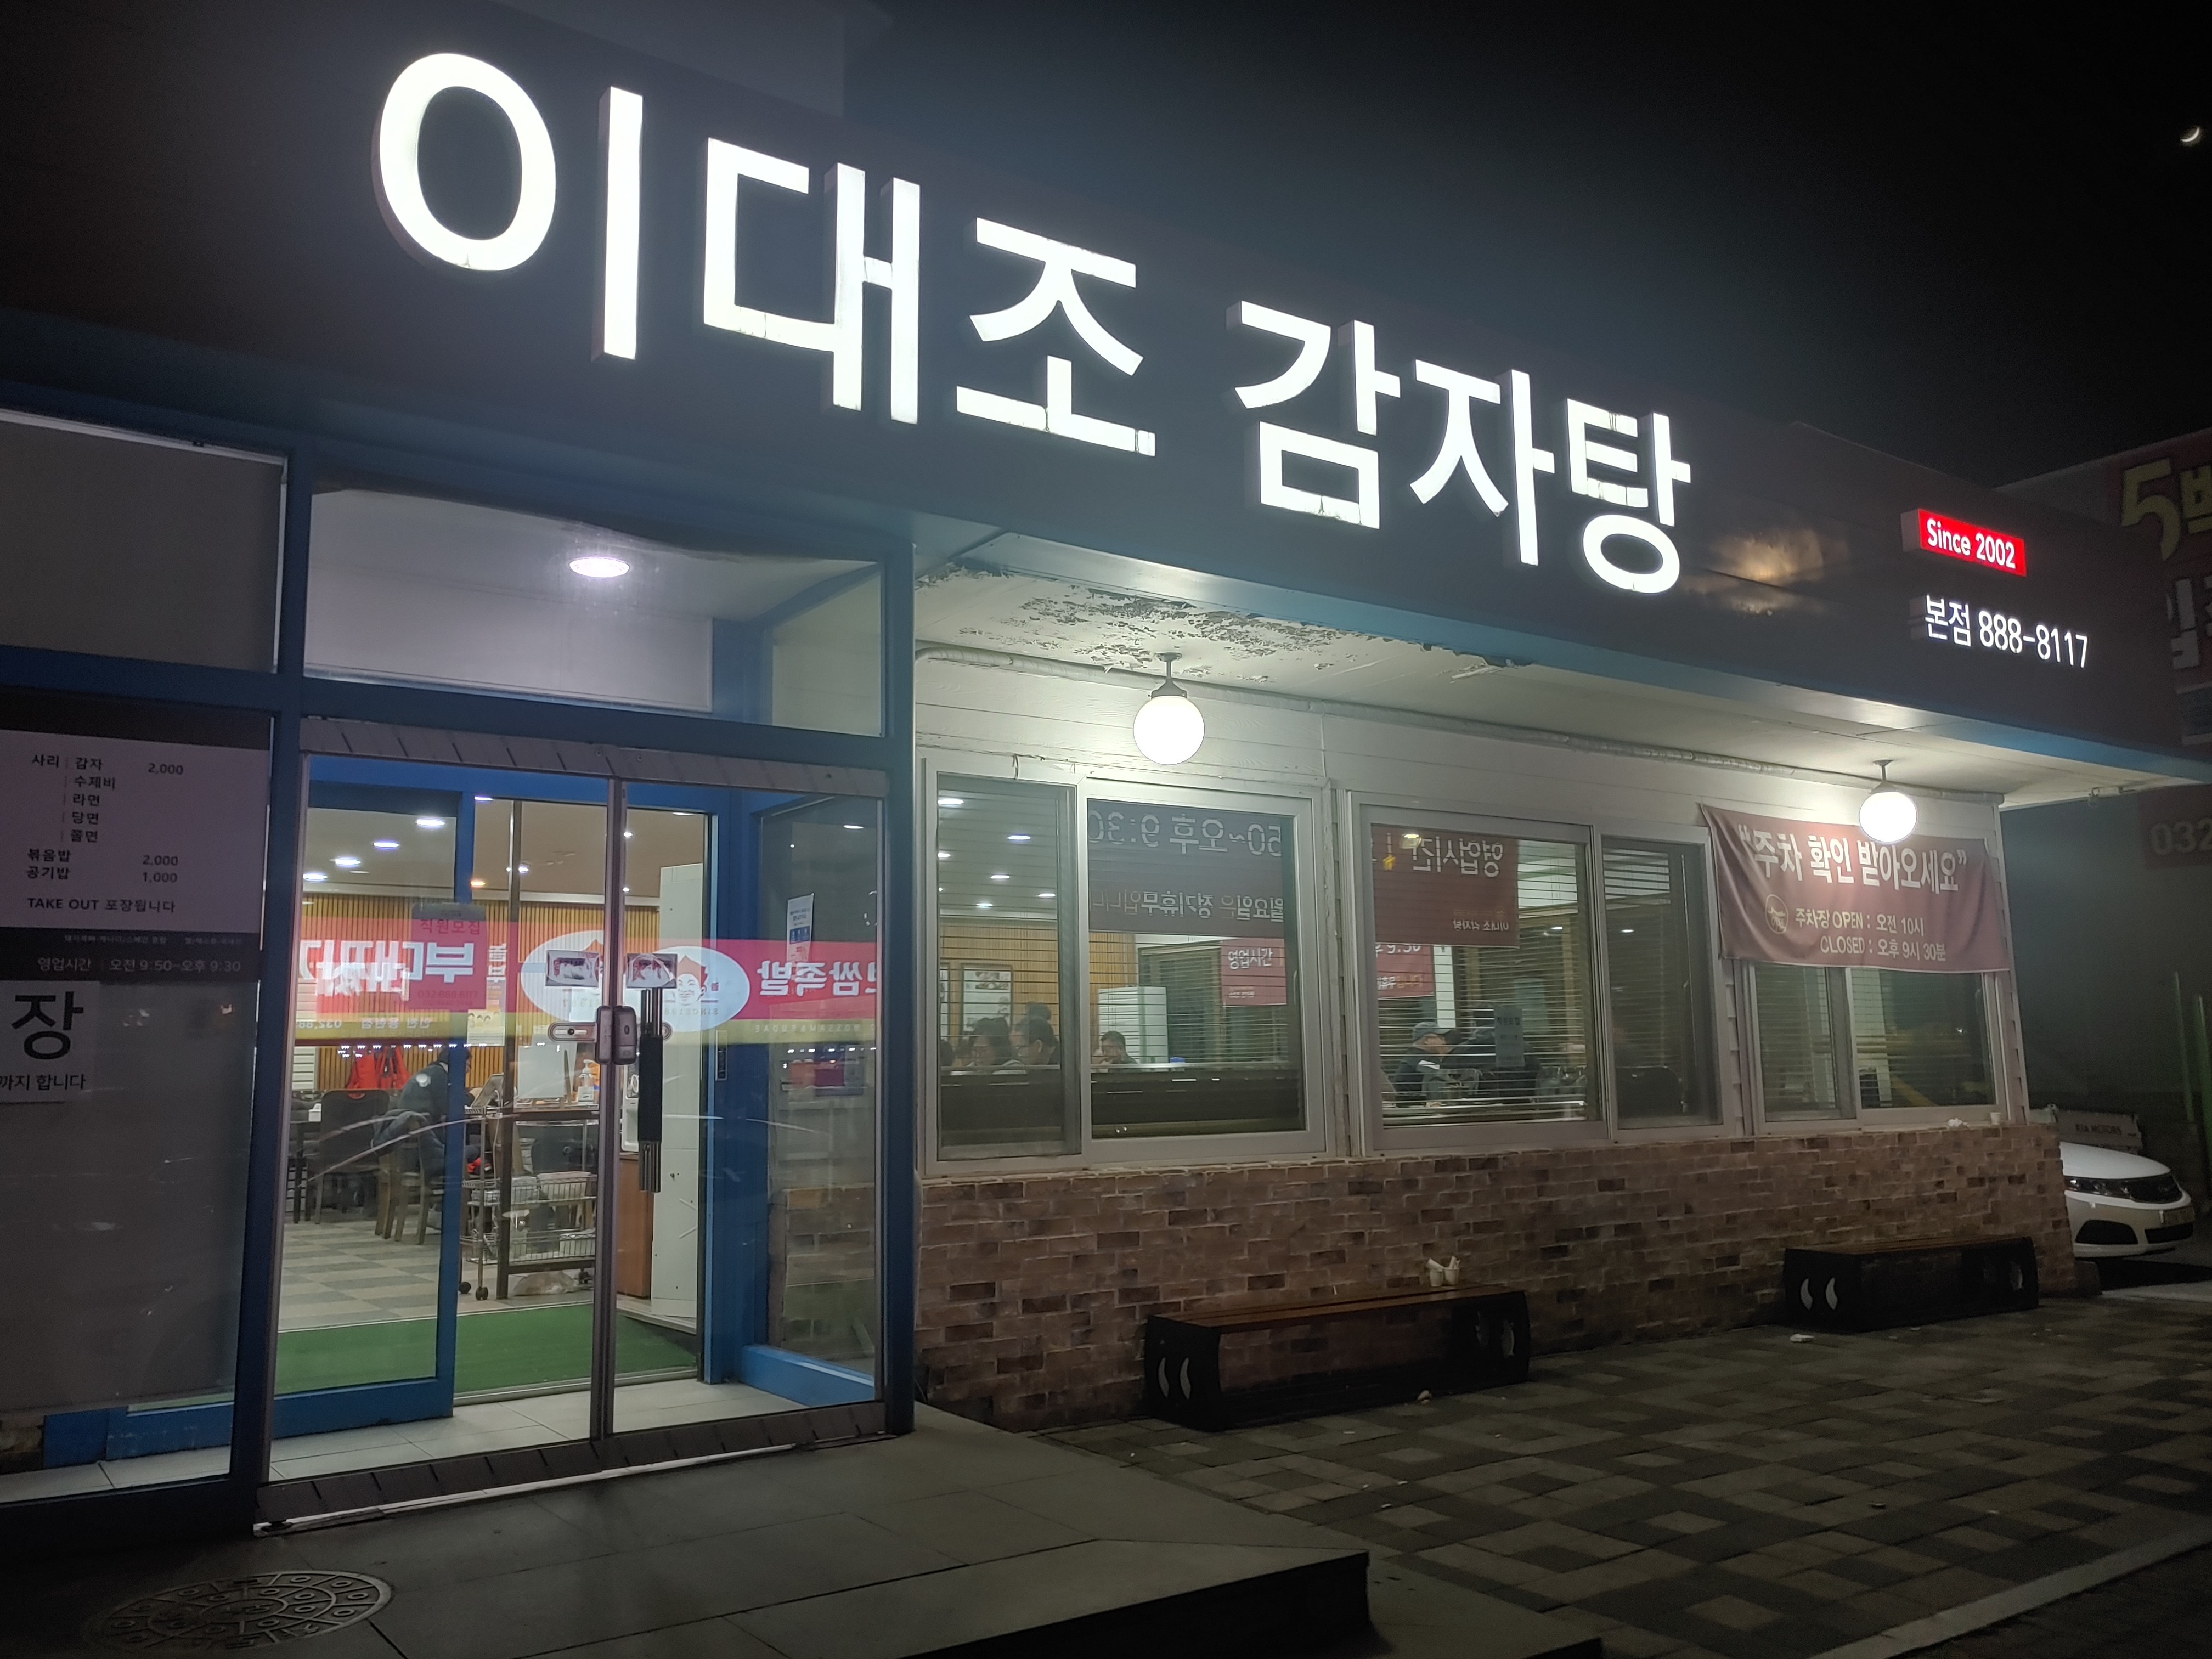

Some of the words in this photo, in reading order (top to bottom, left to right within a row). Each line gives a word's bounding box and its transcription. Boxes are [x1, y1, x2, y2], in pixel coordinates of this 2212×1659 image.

[374, 53, 1156, 457] 이대조
[1230, 300, 1691, 594] 감자탕
[1926, 518, 1971, 556] Since
[1976, 533, 2016, 569] 2002
[1925, 594, 1971, 647] 본점
[1978, 610, 2088, 669] 888-8117
[32, 754, 59, 768] 사리
[75, 757, 103, 771] 감자
[148, 762, 184, 775] 2,000
[74, 775, 116, 791] 수제비
[72, 793, 100, 807] 라면
[71, 811, 99, 825] 당면
[70, 829, 98, 843] 쫄면
[27, 849, 71, 863] 볶음밥
[142, 854, 179, 867] 2,000
[1807, 834, 1855, 884] 확인
[26, 866, 70, 880] 공기밥
[142, 872, 178, 883] 1,000
[27, 897, 64, 910] TAKE
[68, 898, 99, 910] OUT
[104, 899, 176, 913] 포장됩니다
[1795, 908, 1831, 930] 주차장
[1876, 913, 1898, 934] 오전
[1900, 917, 1924, 936] 10시
[1227, 947, 1274, 970] 영업시간
[1877, 938, 1899, 960] 오후
[1902, 941, 1920, 961] 9시
[1923, 943, 1946, 961] 30분
[38, 957, 92, 972] 영업시간
[110, 958, 136, 973] 오전
[210, 960, 241, 973] 9:30
[11, 991, 84, 1060] 장
[36, 1074, 86, 1091] 합니다
